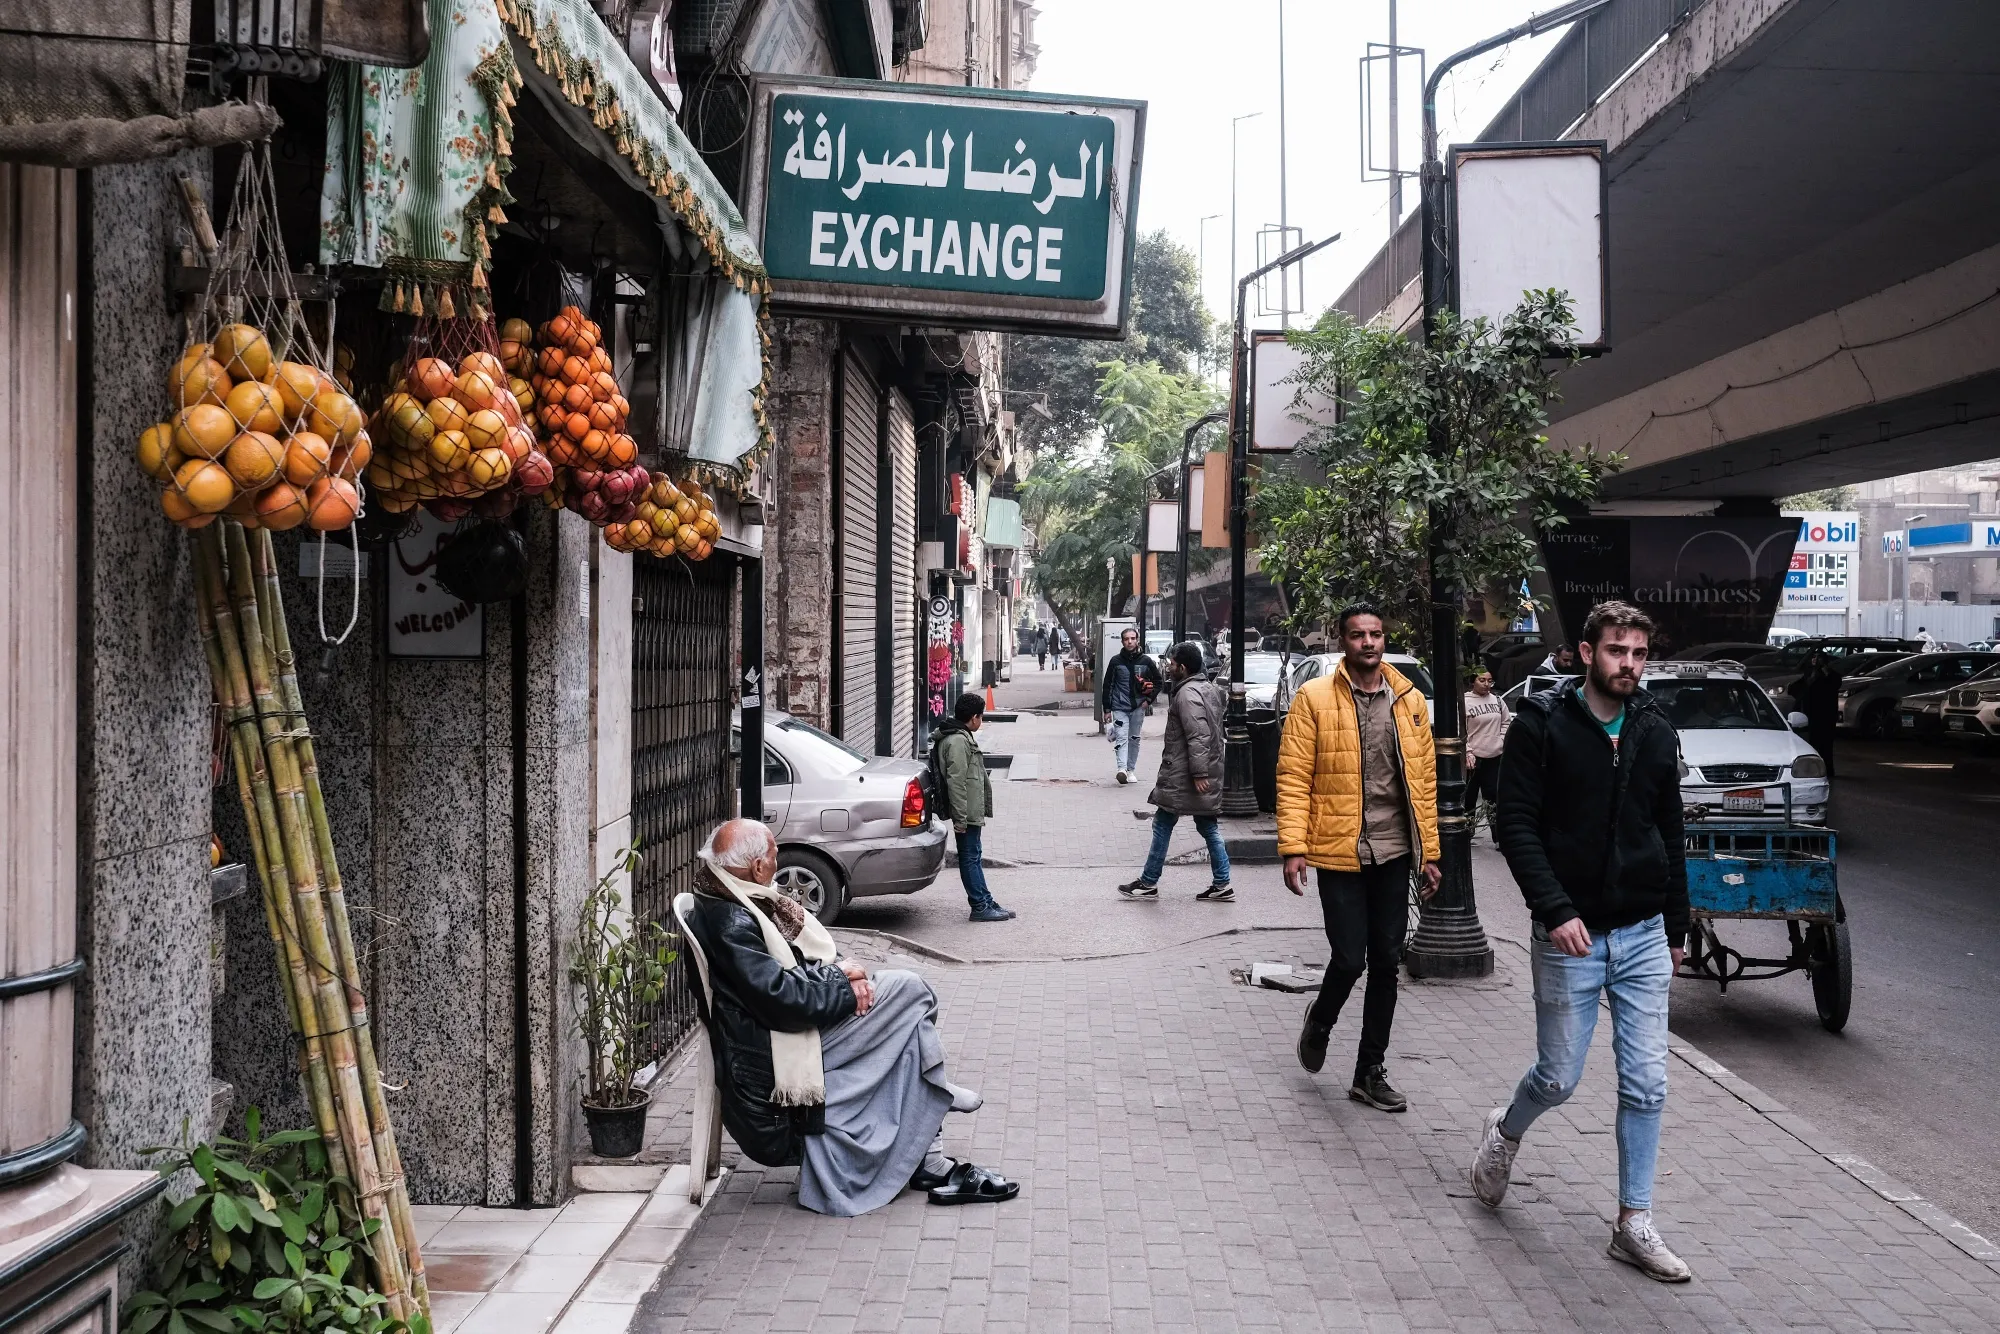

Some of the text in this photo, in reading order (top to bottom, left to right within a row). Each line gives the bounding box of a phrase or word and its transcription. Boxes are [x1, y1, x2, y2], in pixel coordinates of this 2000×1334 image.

[783, 108, 1103, 215] الرضا للصرافة
[809, 211, 1064, 283] EXCHANGE
[1882, 535, 1903, 553] Mob
[1813, 553, 1847, 570] 10.75
[1564, 579, 1624, 594] Breathe
[1807, 571, 1847, 588] 09.25
[1634, 580, 1761, 603] calmness
[1682, 665, 1703, 674] TAXI
[1467, 703, 1502, 718] BALANC
